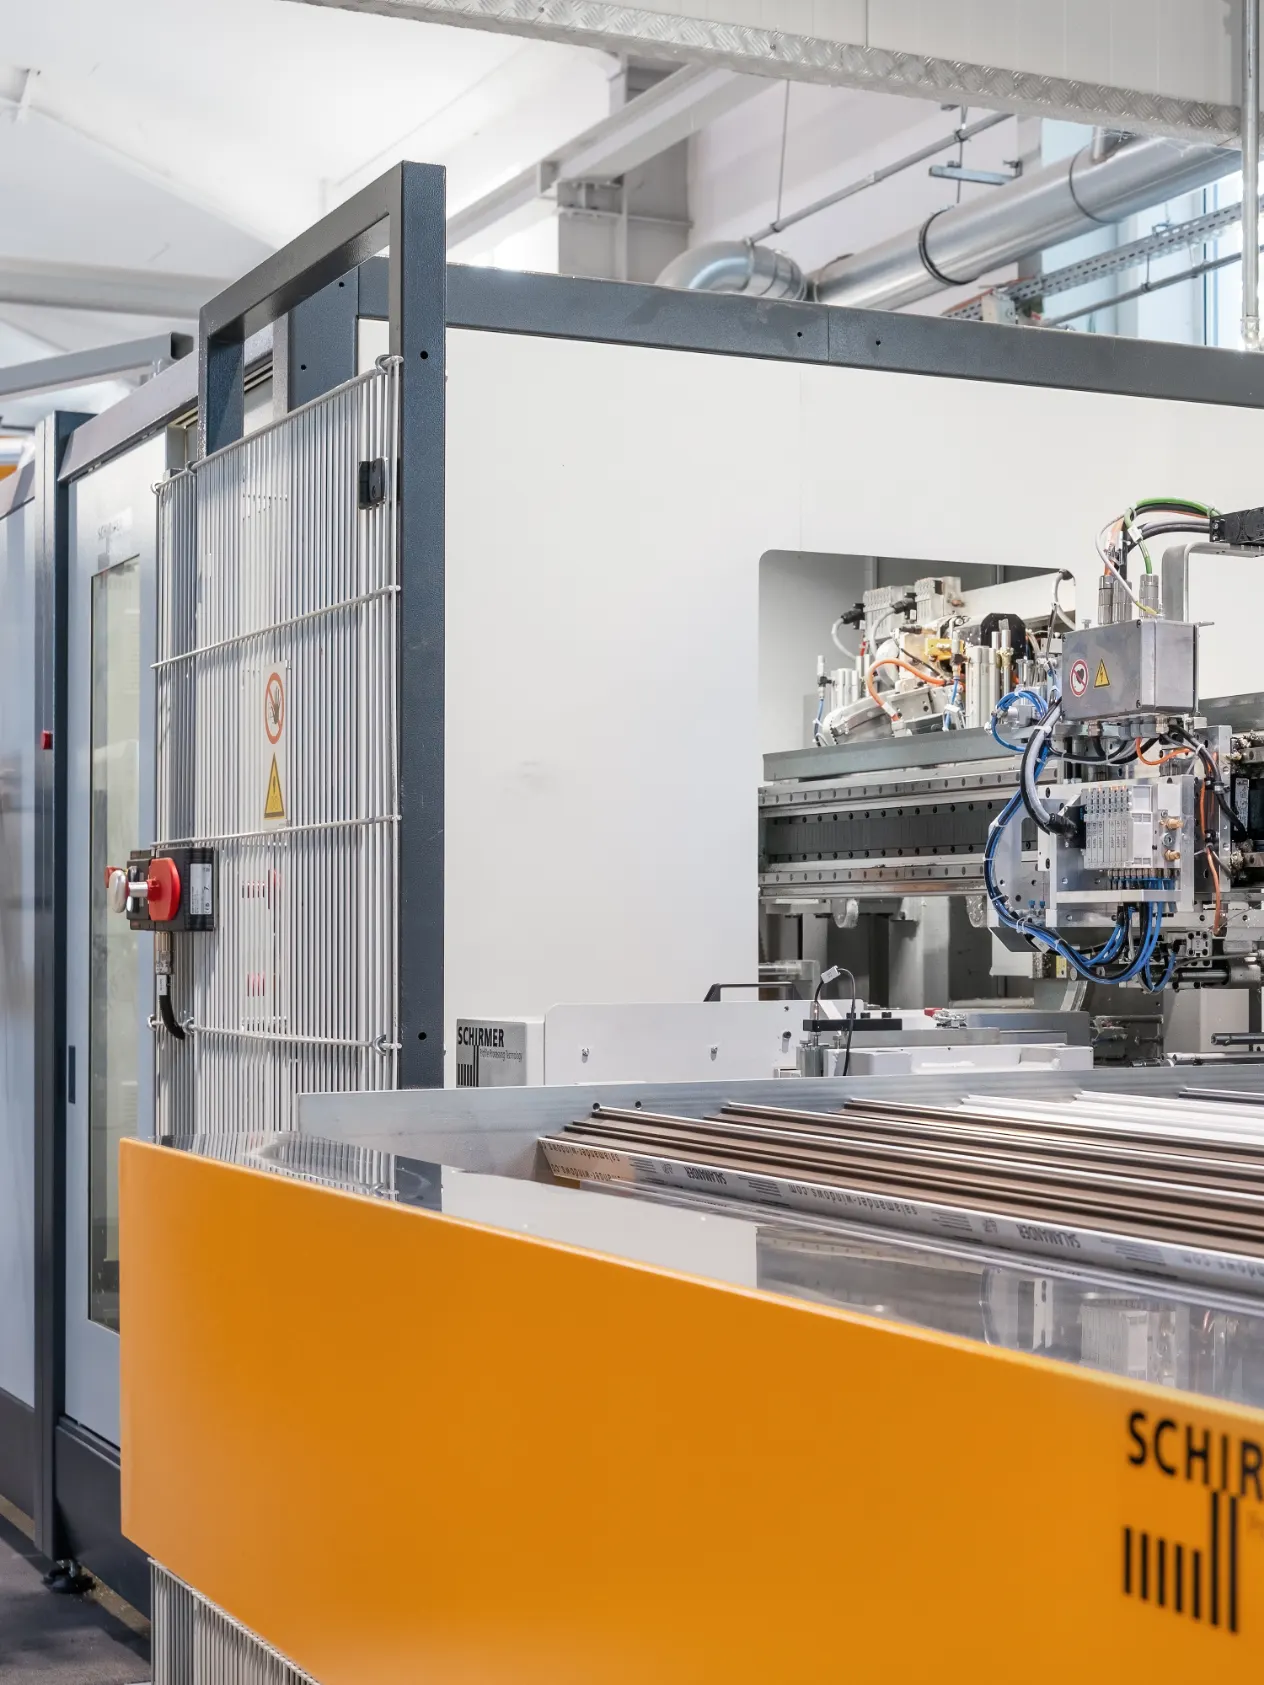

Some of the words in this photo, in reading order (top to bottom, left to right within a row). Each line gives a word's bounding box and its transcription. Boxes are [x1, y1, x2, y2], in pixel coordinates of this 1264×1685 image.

[457, 1026, 505, 1048] SCHIRMER
[684, 1166, 728, 1185] SALAMANDER
[788, 1183, 918, 1216] salamander-windows.com
[1016, 1223, 1081, 1249] SALAMANDER
